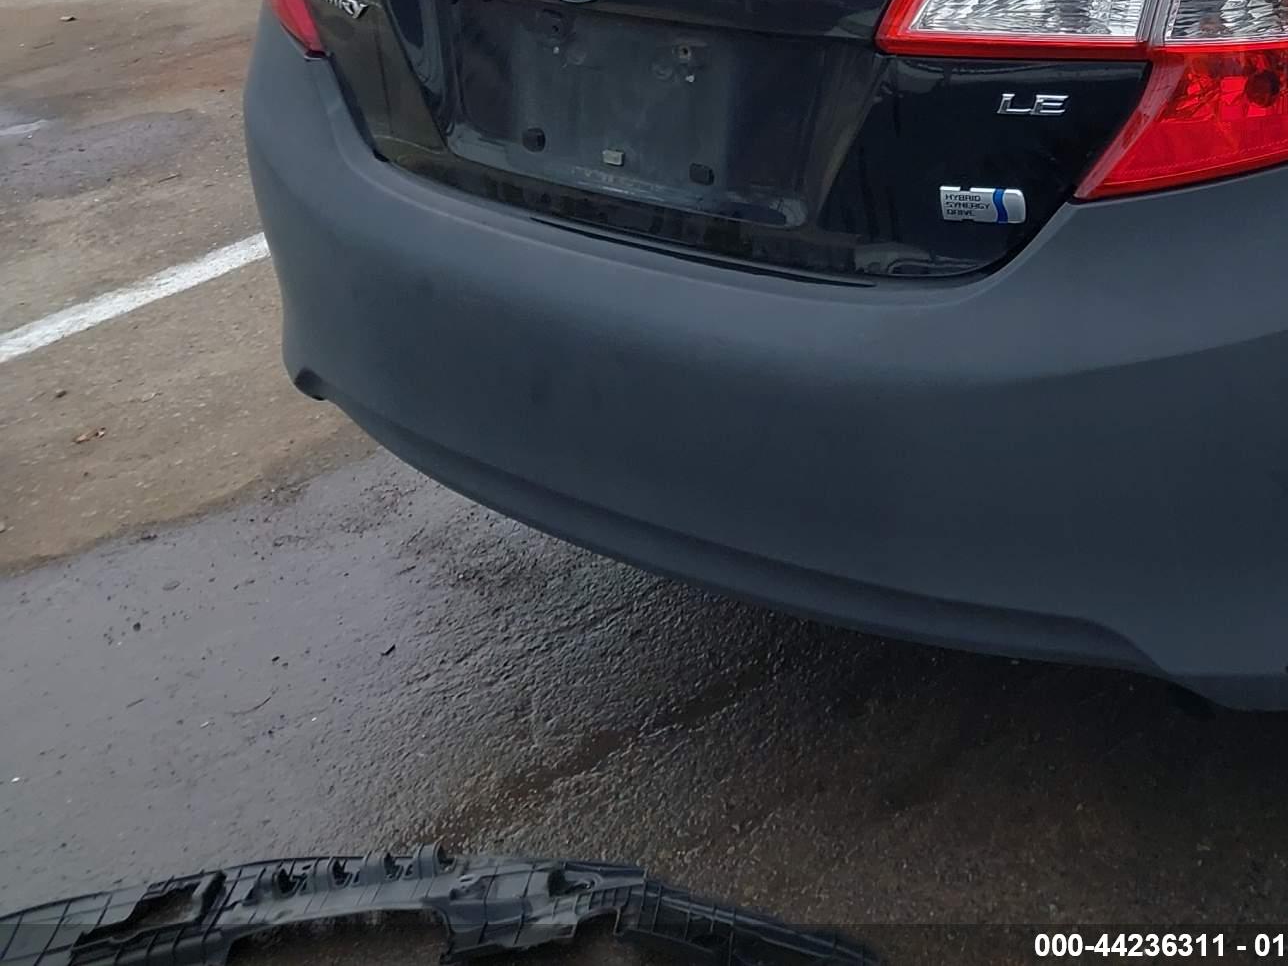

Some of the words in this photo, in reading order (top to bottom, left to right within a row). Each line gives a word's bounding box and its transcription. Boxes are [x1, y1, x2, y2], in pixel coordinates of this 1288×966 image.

[997, 93, 1069, 115] LE
[945, 193, 981, 202] HYBRID
[945, 201, 990, 210] SYNERGY
[946, 209, 976, 217] DRIVE
